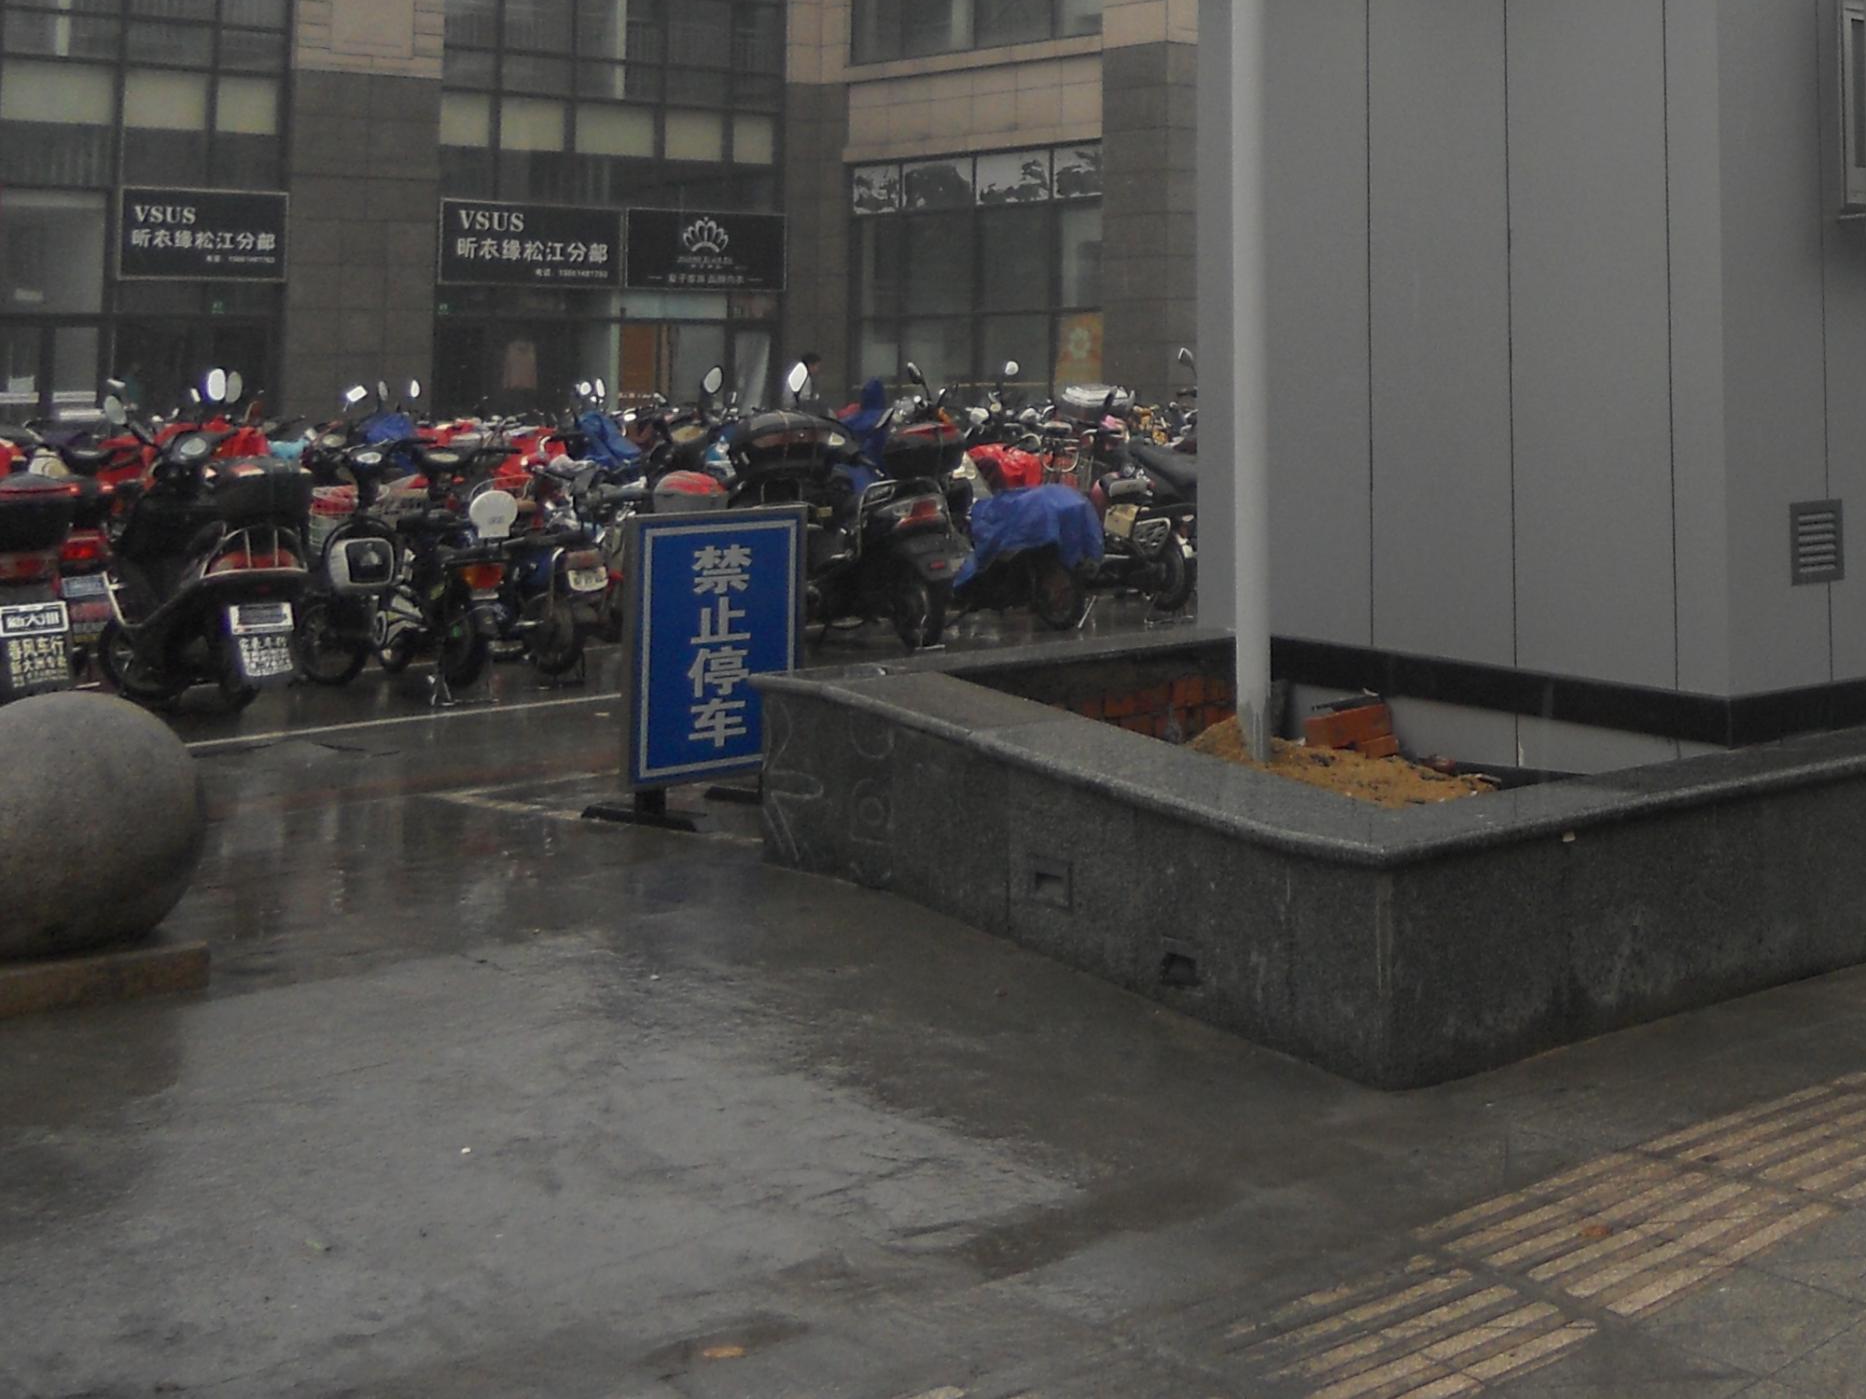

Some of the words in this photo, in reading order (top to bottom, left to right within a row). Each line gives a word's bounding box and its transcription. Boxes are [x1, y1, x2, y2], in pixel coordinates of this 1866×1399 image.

[134, 205, 196, 224] VSUS
[459, 210, 525, 232] VSUS
[688, 545, 752, 748] 禁止停车
